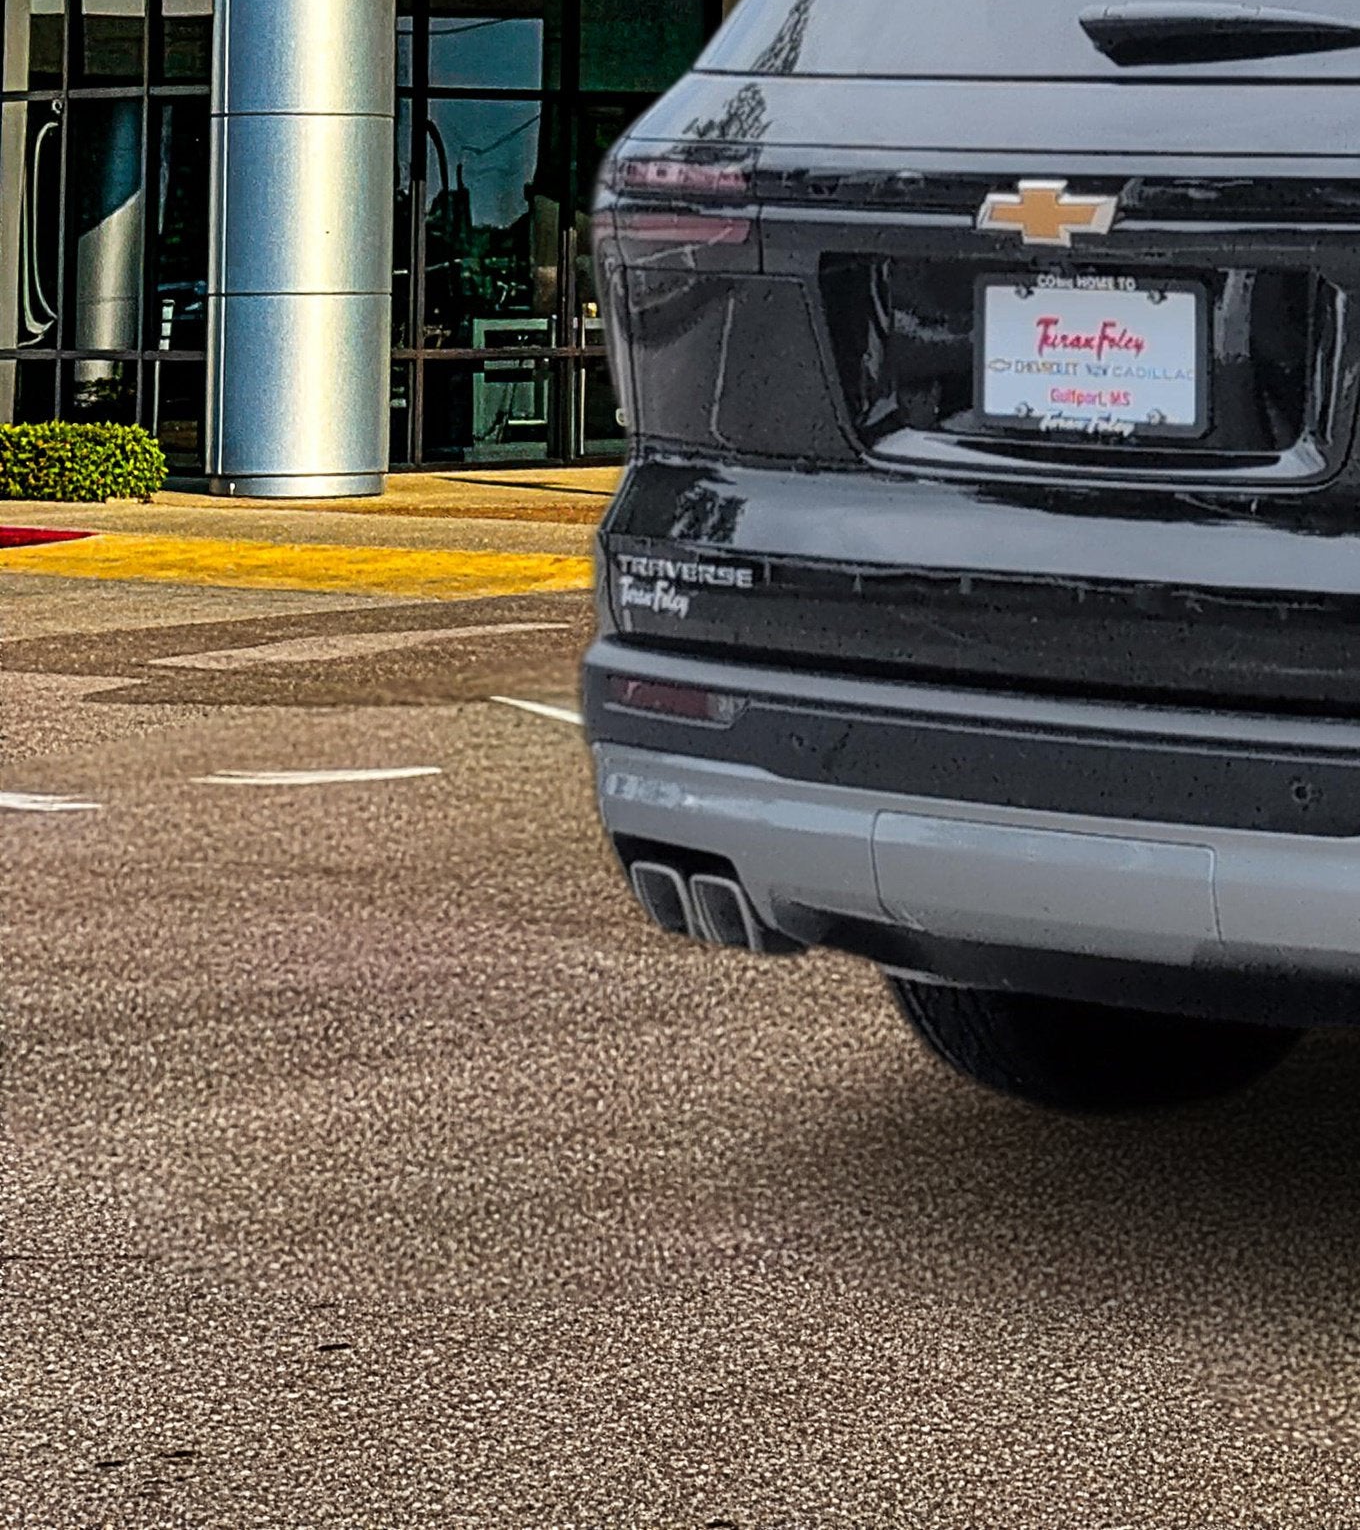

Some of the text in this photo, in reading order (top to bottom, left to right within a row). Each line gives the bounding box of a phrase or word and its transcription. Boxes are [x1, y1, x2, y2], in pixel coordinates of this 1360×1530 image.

[1116, 276, 1137, 292] TO
[1109, 389, 1132, 408] MS
[617, 554, 754, 589] TRAVERSE
